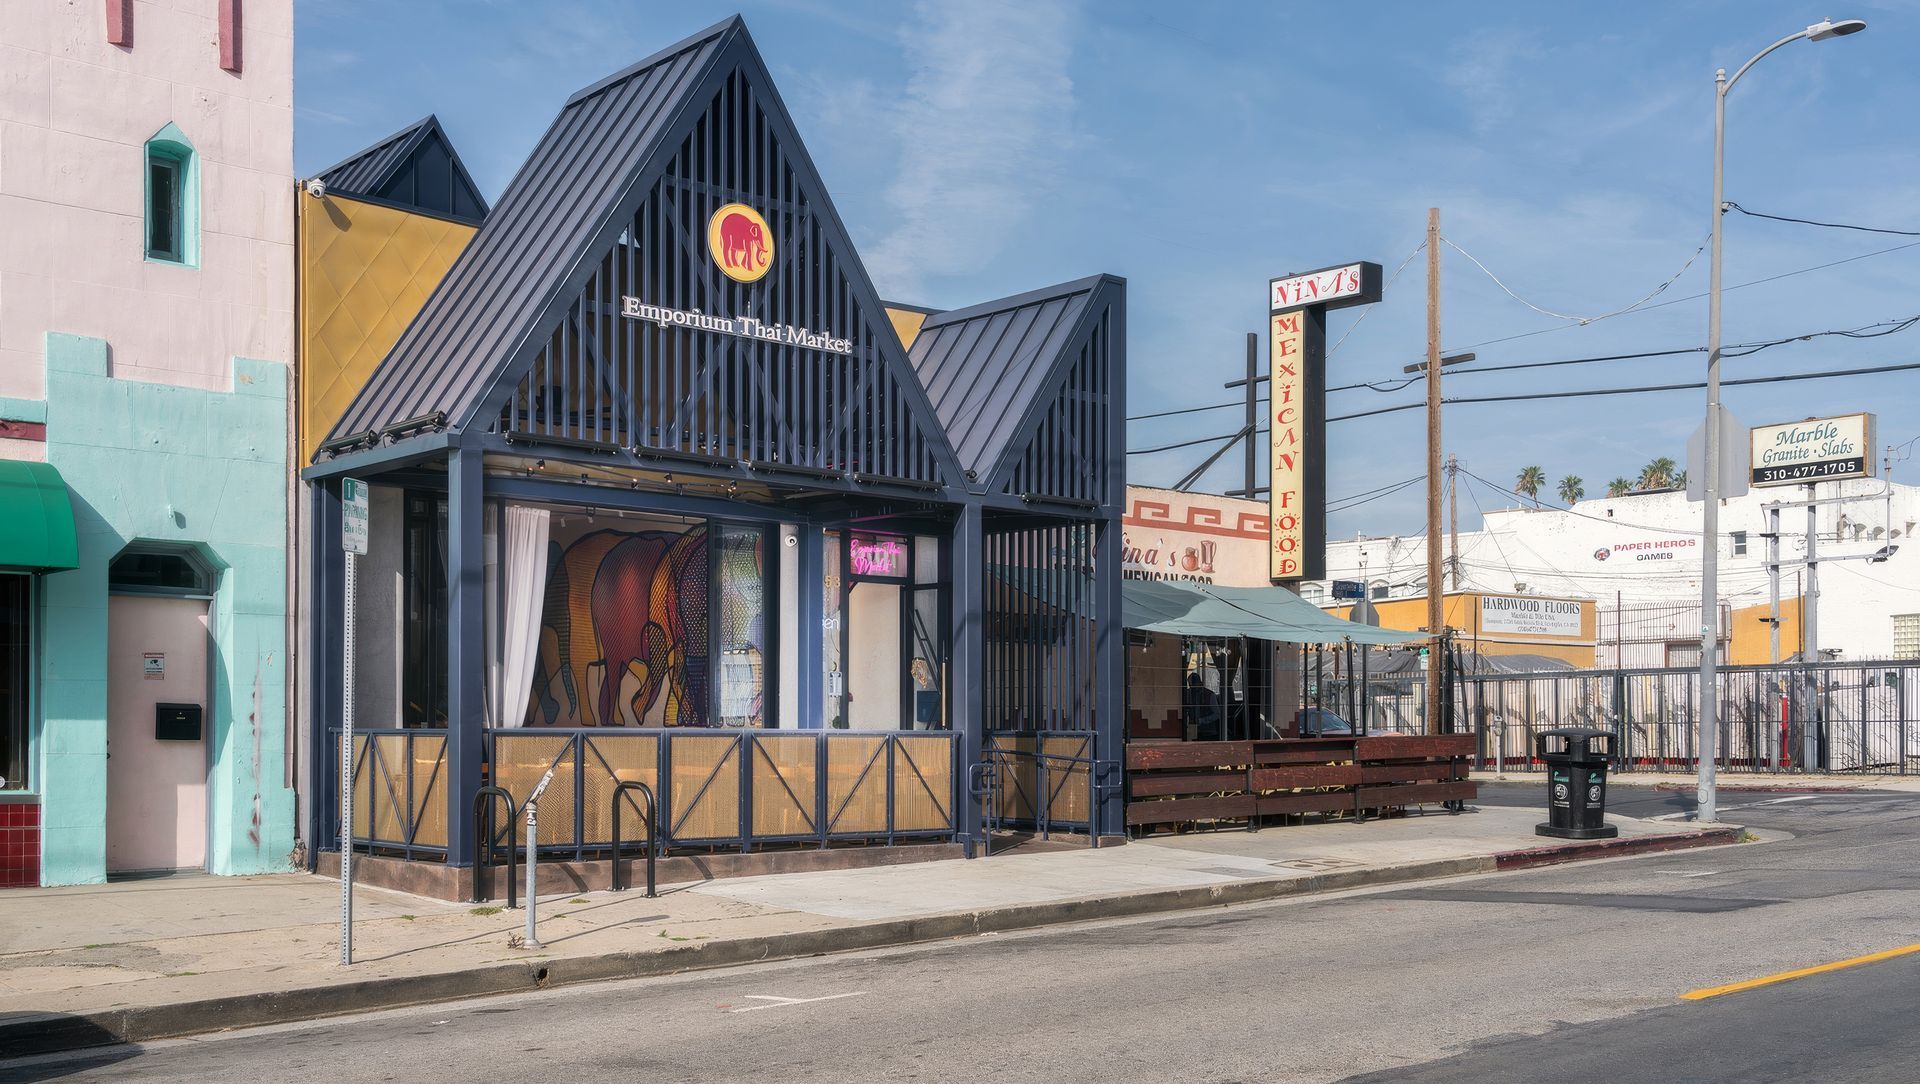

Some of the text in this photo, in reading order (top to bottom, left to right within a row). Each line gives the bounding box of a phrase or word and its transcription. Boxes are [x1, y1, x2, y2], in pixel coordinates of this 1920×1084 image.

[622, 295, 853, 354] Emporium Thai Market
[1775, 422, 1838, 447] Marble
[1763, 438, 1854, 467] Granite Slabs
[1763, 461, 1856, 481] 310-477-1705
[1275, 490, 1300, 577] FOOD
[1614, 538, 1696, 552] PAPER HEROS
[1636, 552, 1673, 562] GAMES
[1483, 596, 1580, 615] HARDWOOD FLOORS
